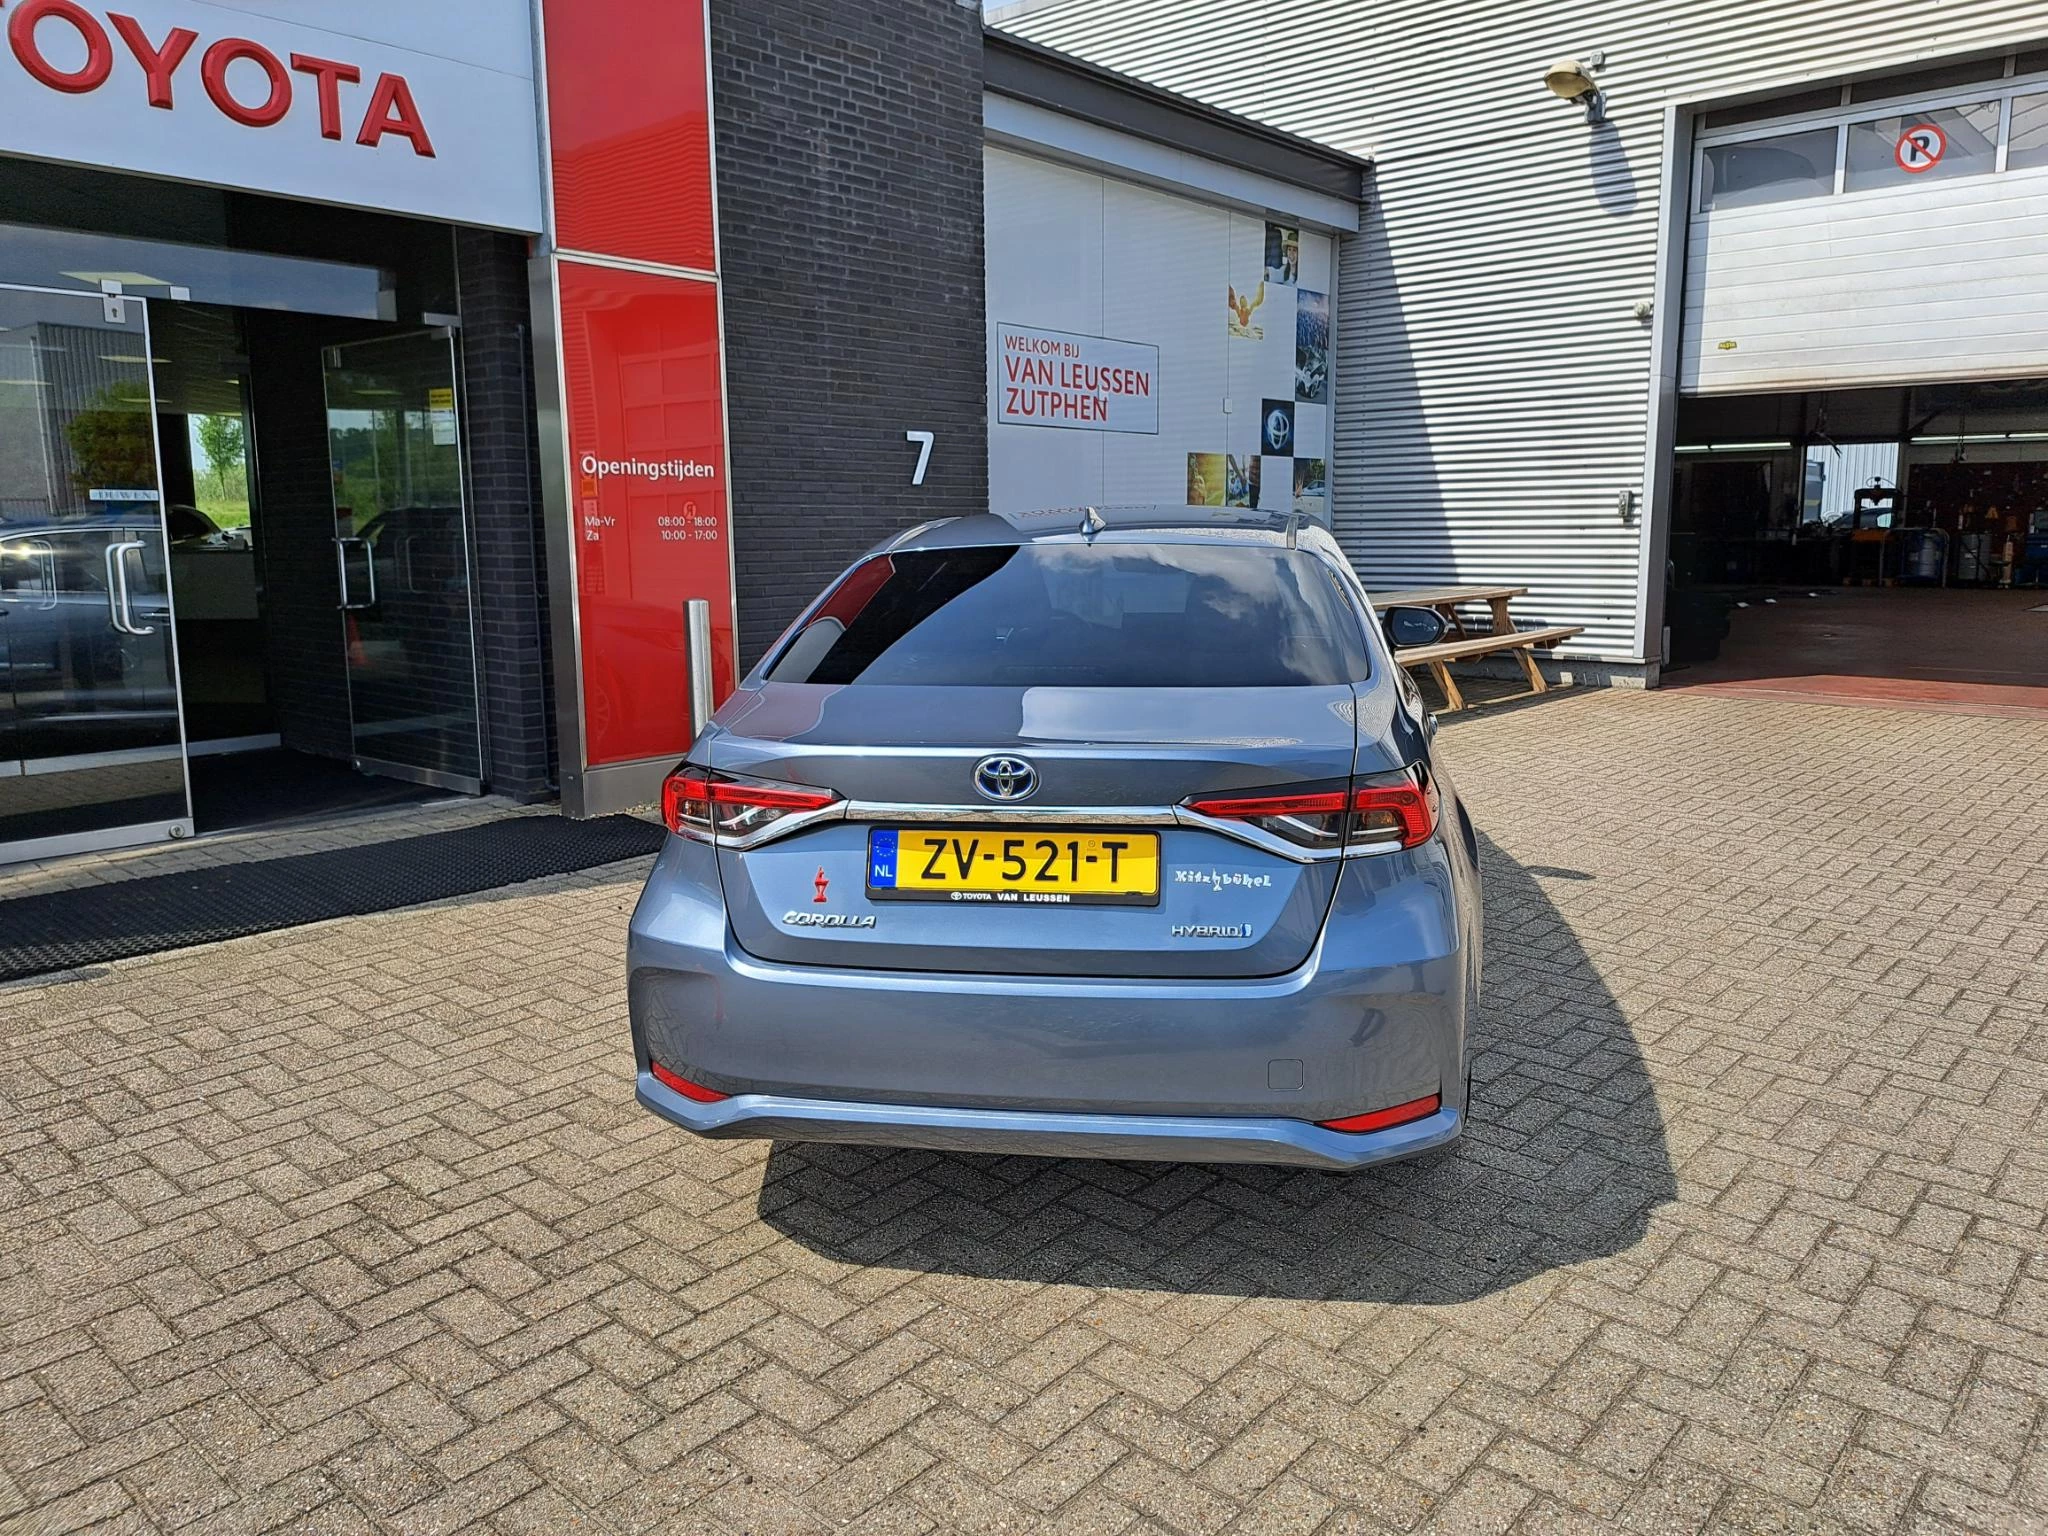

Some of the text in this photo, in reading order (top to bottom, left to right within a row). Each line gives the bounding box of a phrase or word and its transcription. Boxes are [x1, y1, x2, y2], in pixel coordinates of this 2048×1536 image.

[0, 0, 436, 158] OYOTA
[1005, 335, 1080, 358] WELKOM BIJ
[1005, 355, 1150, 397] VAN LEUSSEN
[1006, 387, 1108, 422] ZUTPHEN
[581, 456, 715, 481] Openingstijden
[906, 430, 935, 485] 7
[584, 516, 616, 527] Ma-Vr
[657, 516, 685, 527] 08:00
[693, 516, 717, 527] 18:00
[586, 530, 599, 541] Za
[661, 530, 686, 540] 10:00
[694, 530, 718, 540] 17:00
[874, 865, 893, 878] NL
[921, 838, 1128, 883] ZV-521-T
[997, 893, 1018, 901] VAN
[1023, 893, 1070, 903] LEUSSEN
[783, 910, 876, 928] COROLLA
[1171, 925, 1239, 938] HYBRID
